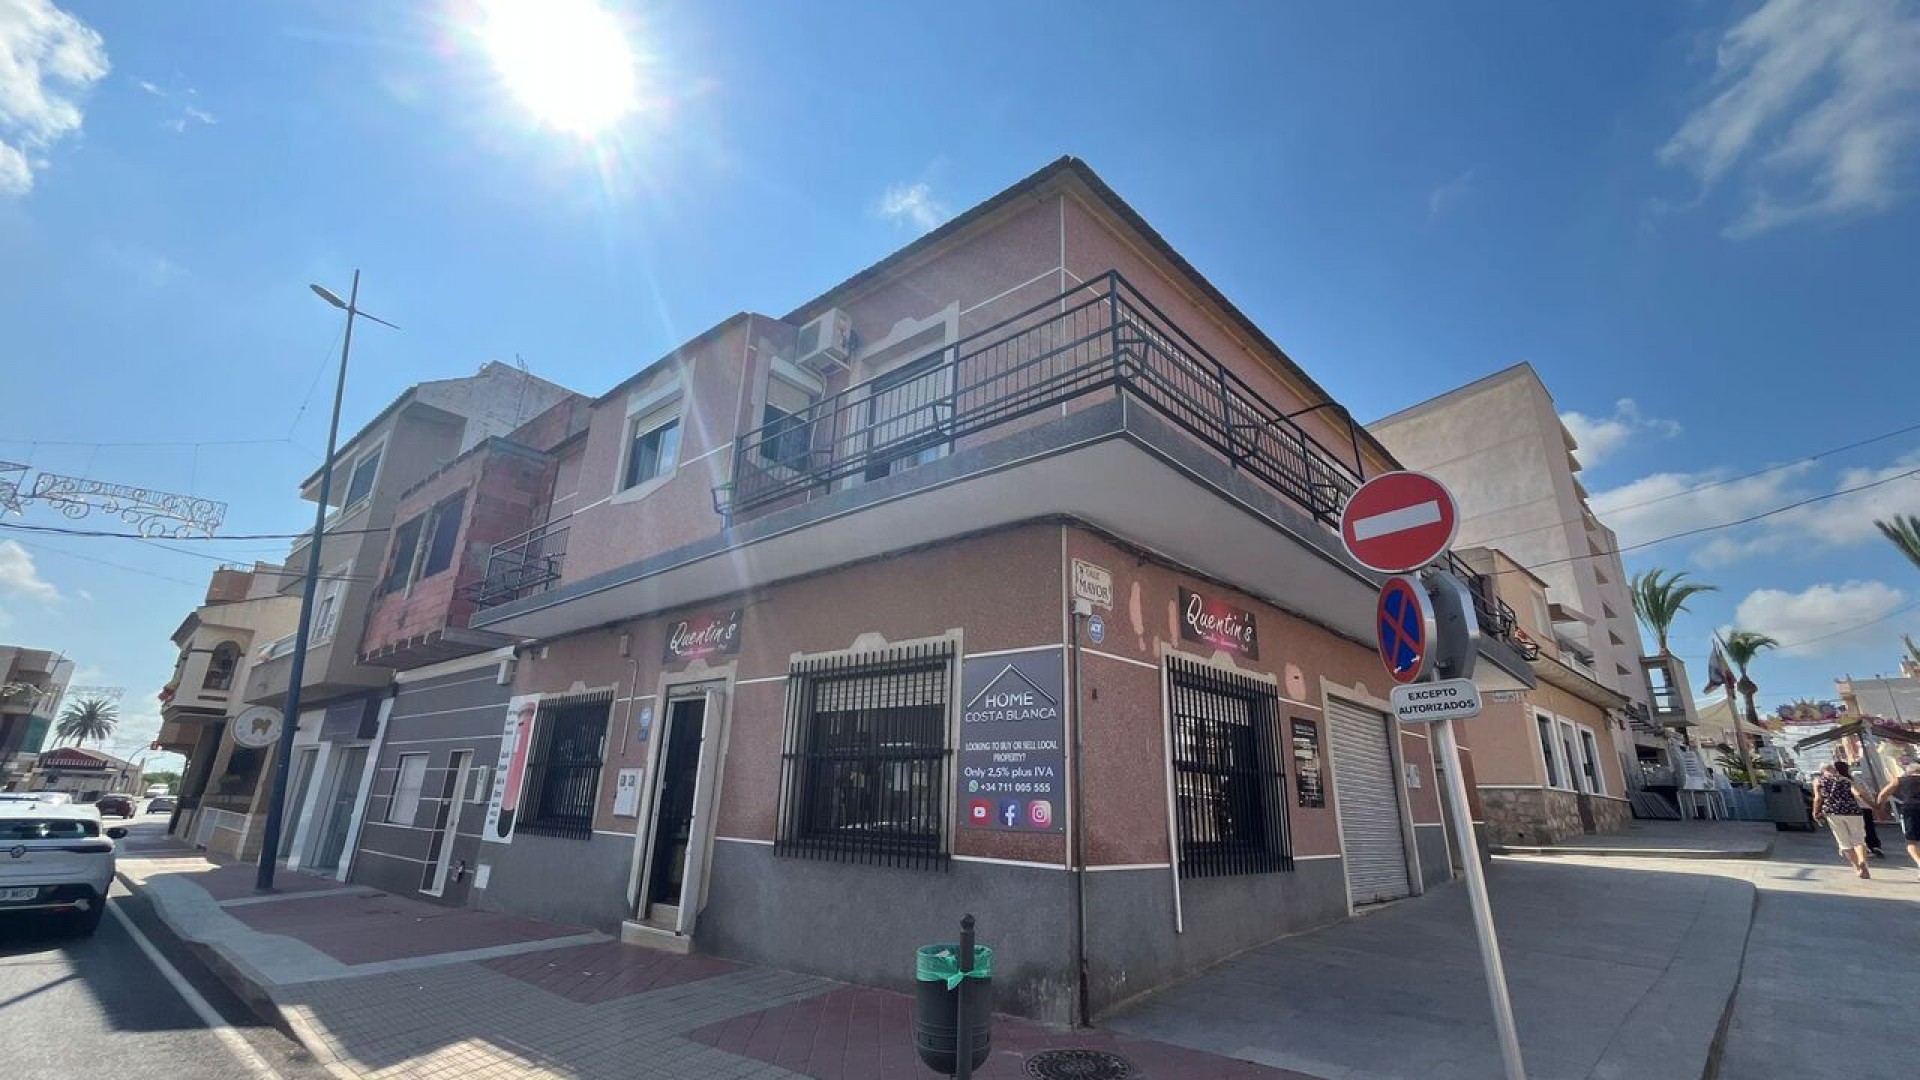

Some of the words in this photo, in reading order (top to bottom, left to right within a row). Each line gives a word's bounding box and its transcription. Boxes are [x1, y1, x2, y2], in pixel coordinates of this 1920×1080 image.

[1079, 579, 1109, 601] MAYOR
[1187, 593, 1252, 642] Quentin's
[670, 611, 737, 655] Quentin's
[985, 692, 1034, 708] HOME
[1408, 687, 1458, 701] EXCEPTO
[965, 710, 1004, 722] COSTA
[1006, 707, 1057, 721] BLANCA
[1399, 699, 1475, 715] AUTORIZADOS
[964, 767, 985, 778] Only
[1012, 767, 1032, 779] plus
[1034, 766, 1054, 777] IVA
[980, 782, 996, 792] +34
[998, 782, 1012, 792] 711
[1034, 782, 1051, 793] 555
